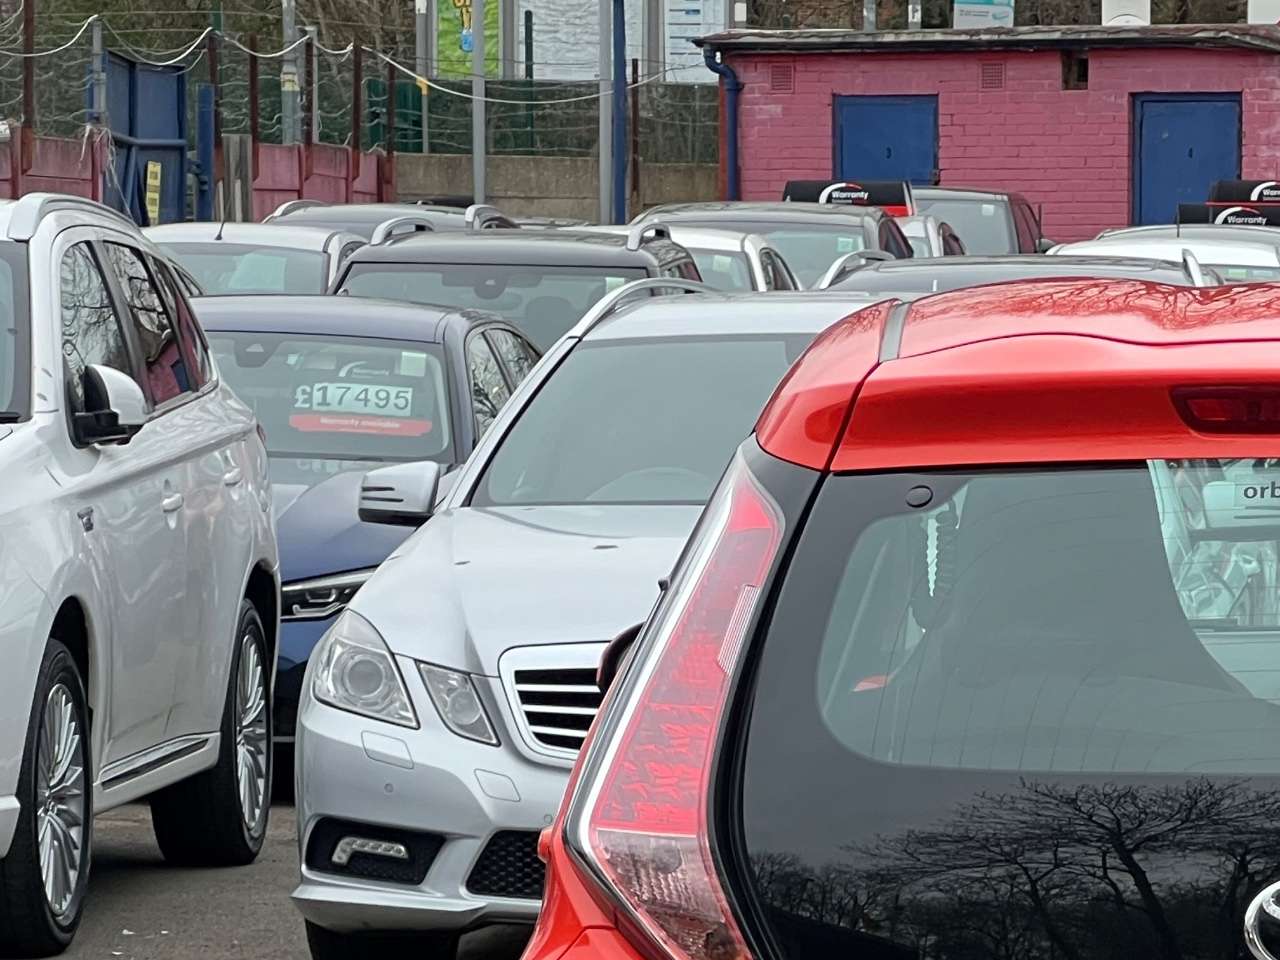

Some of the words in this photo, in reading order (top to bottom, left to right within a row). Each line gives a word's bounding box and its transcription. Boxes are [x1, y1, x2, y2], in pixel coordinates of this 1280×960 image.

[831, 191, 869, 200] Warranty
[1227, 215, 1267, 226] Warranty
[294, 383, 410, 411] £17495
